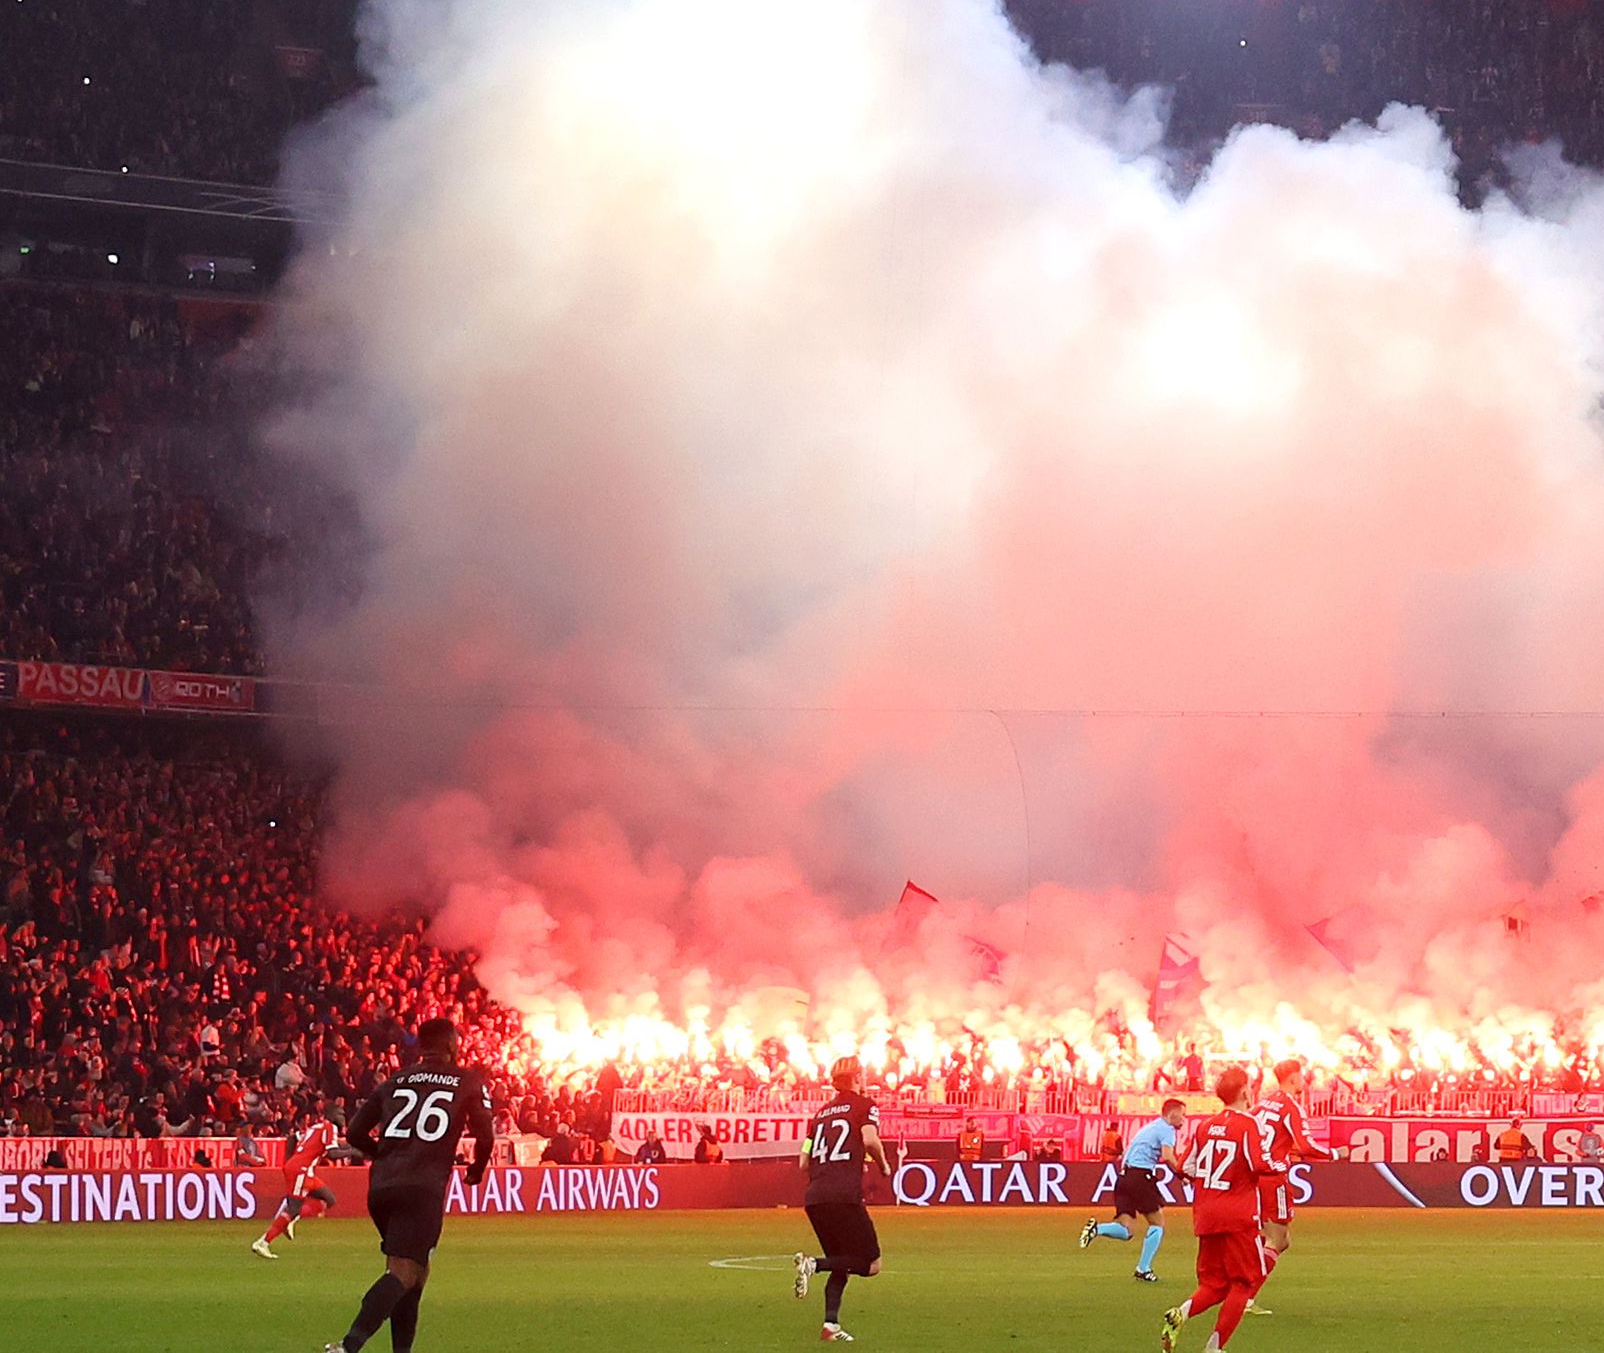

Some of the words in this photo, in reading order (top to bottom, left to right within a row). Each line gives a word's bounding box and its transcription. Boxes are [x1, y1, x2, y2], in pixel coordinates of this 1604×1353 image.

[17, 662, 144, 700] PASSAU
[384, 1088, 454, 1142] 26
[811, 1118, 851, 1164] 42
[892, 1162, 1070, 1207] QATAR
[1196, 1138, 1237, 1191] 42
[536, 1167, 660, 1210] AIRWAYS
